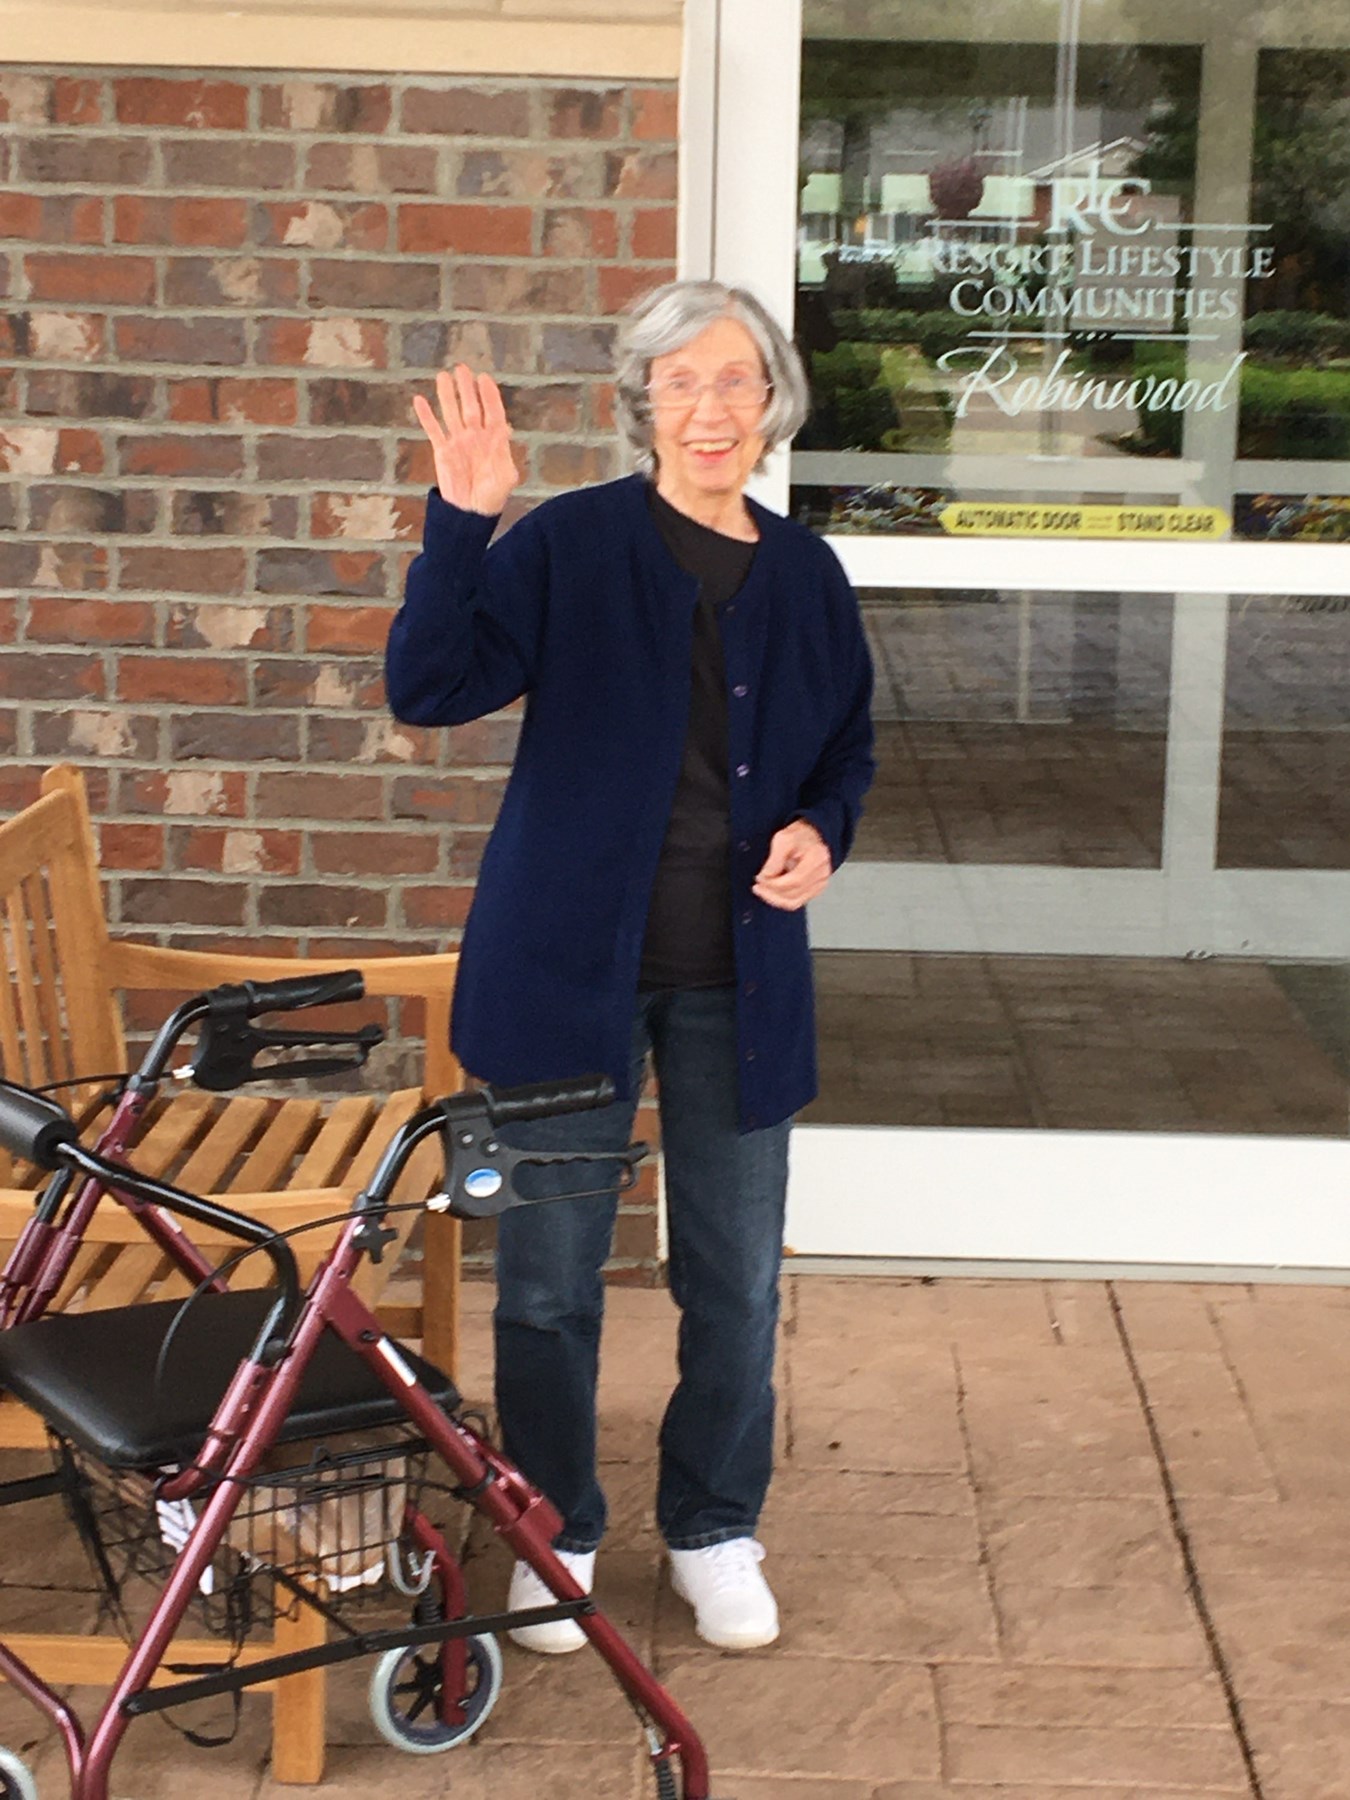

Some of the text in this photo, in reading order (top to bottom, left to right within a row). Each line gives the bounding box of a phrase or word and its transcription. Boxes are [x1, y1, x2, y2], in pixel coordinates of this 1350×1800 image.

[1079, 239, 1276, 279] LIFESTYLE
[949, 278, 1239, 320] COMMUNITIES
[936, 344, 1249, 418] Robinwood
[955, 509, 1214, 533] AUTOMATIC DOOR STAND CLEAR
